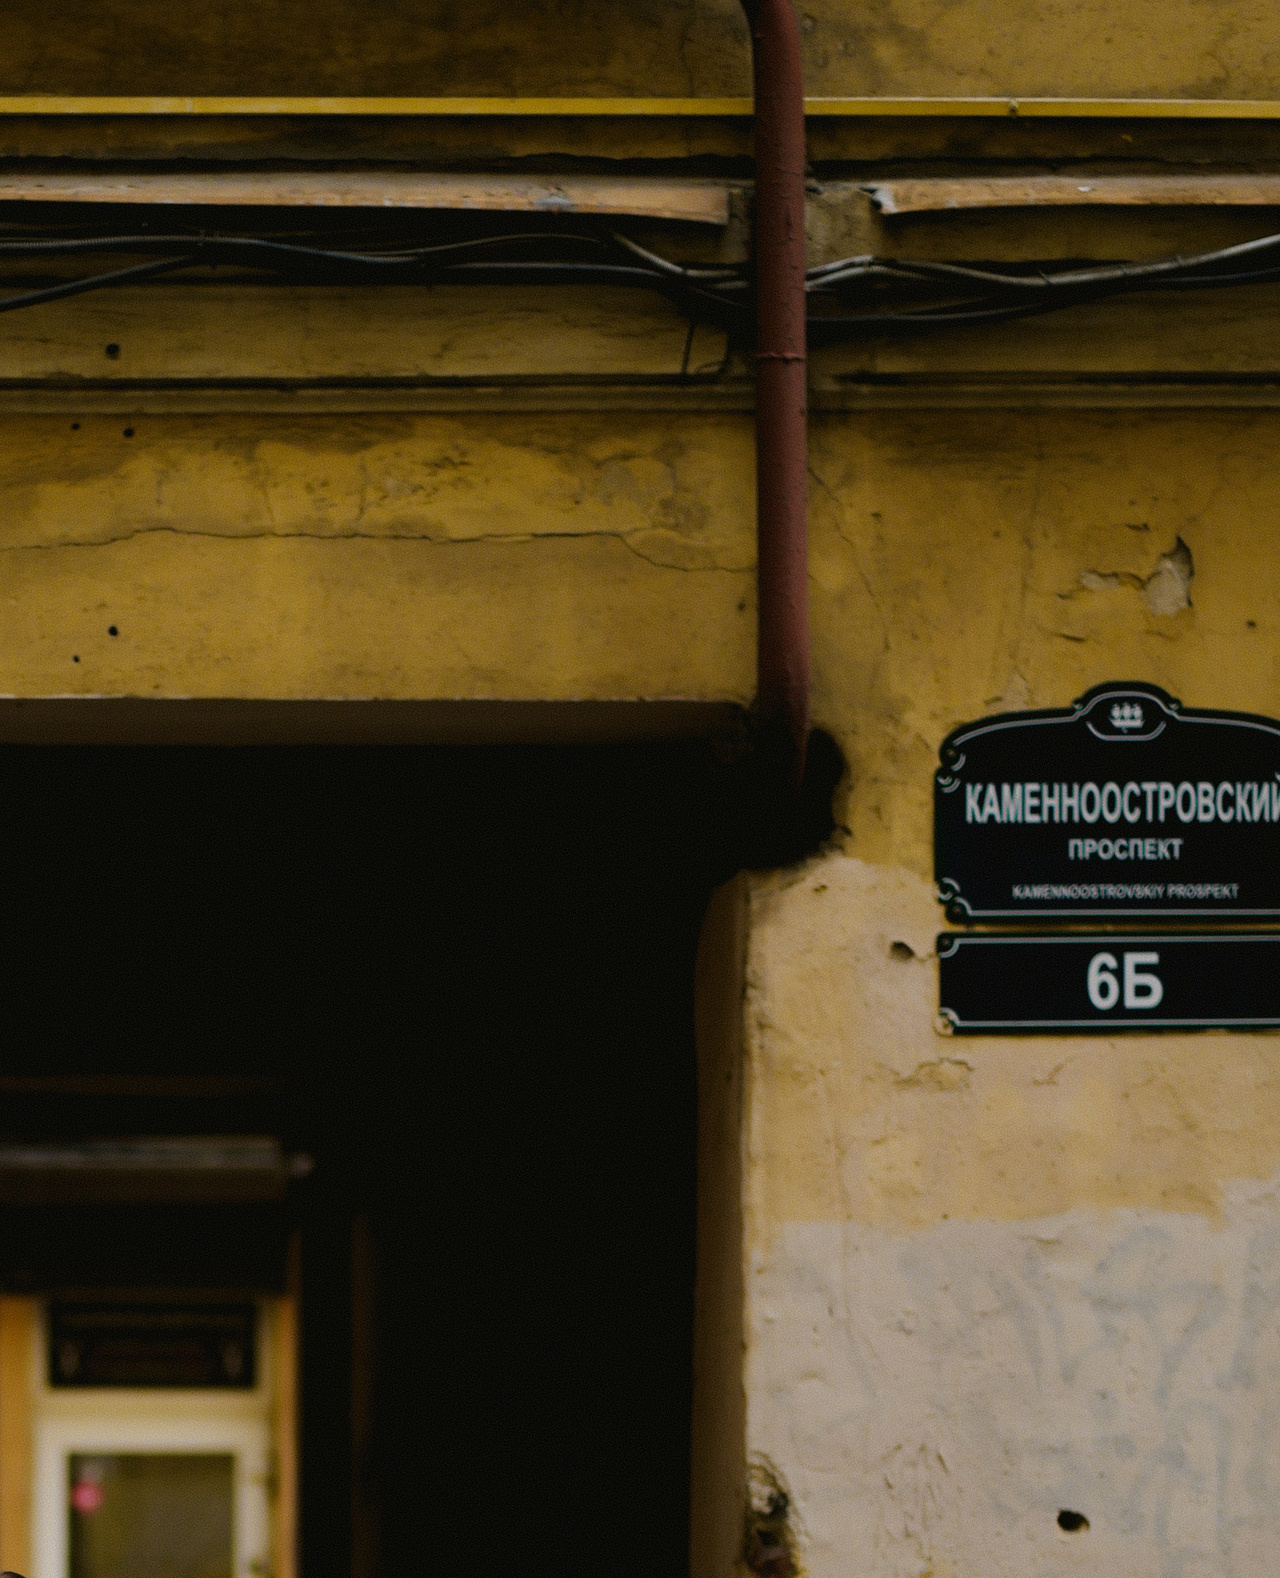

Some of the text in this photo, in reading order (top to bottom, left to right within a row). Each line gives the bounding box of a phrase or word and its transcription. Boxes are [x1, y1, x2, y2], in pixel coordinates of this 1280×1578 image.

[1068, 838, 1184, 860] ПРОСПЕКТ
[1012, 883, 1239, 899] KAMENNOOSTROVSKIY PROSPEKT
[1087, 952, 1163, 1010] 6Б
